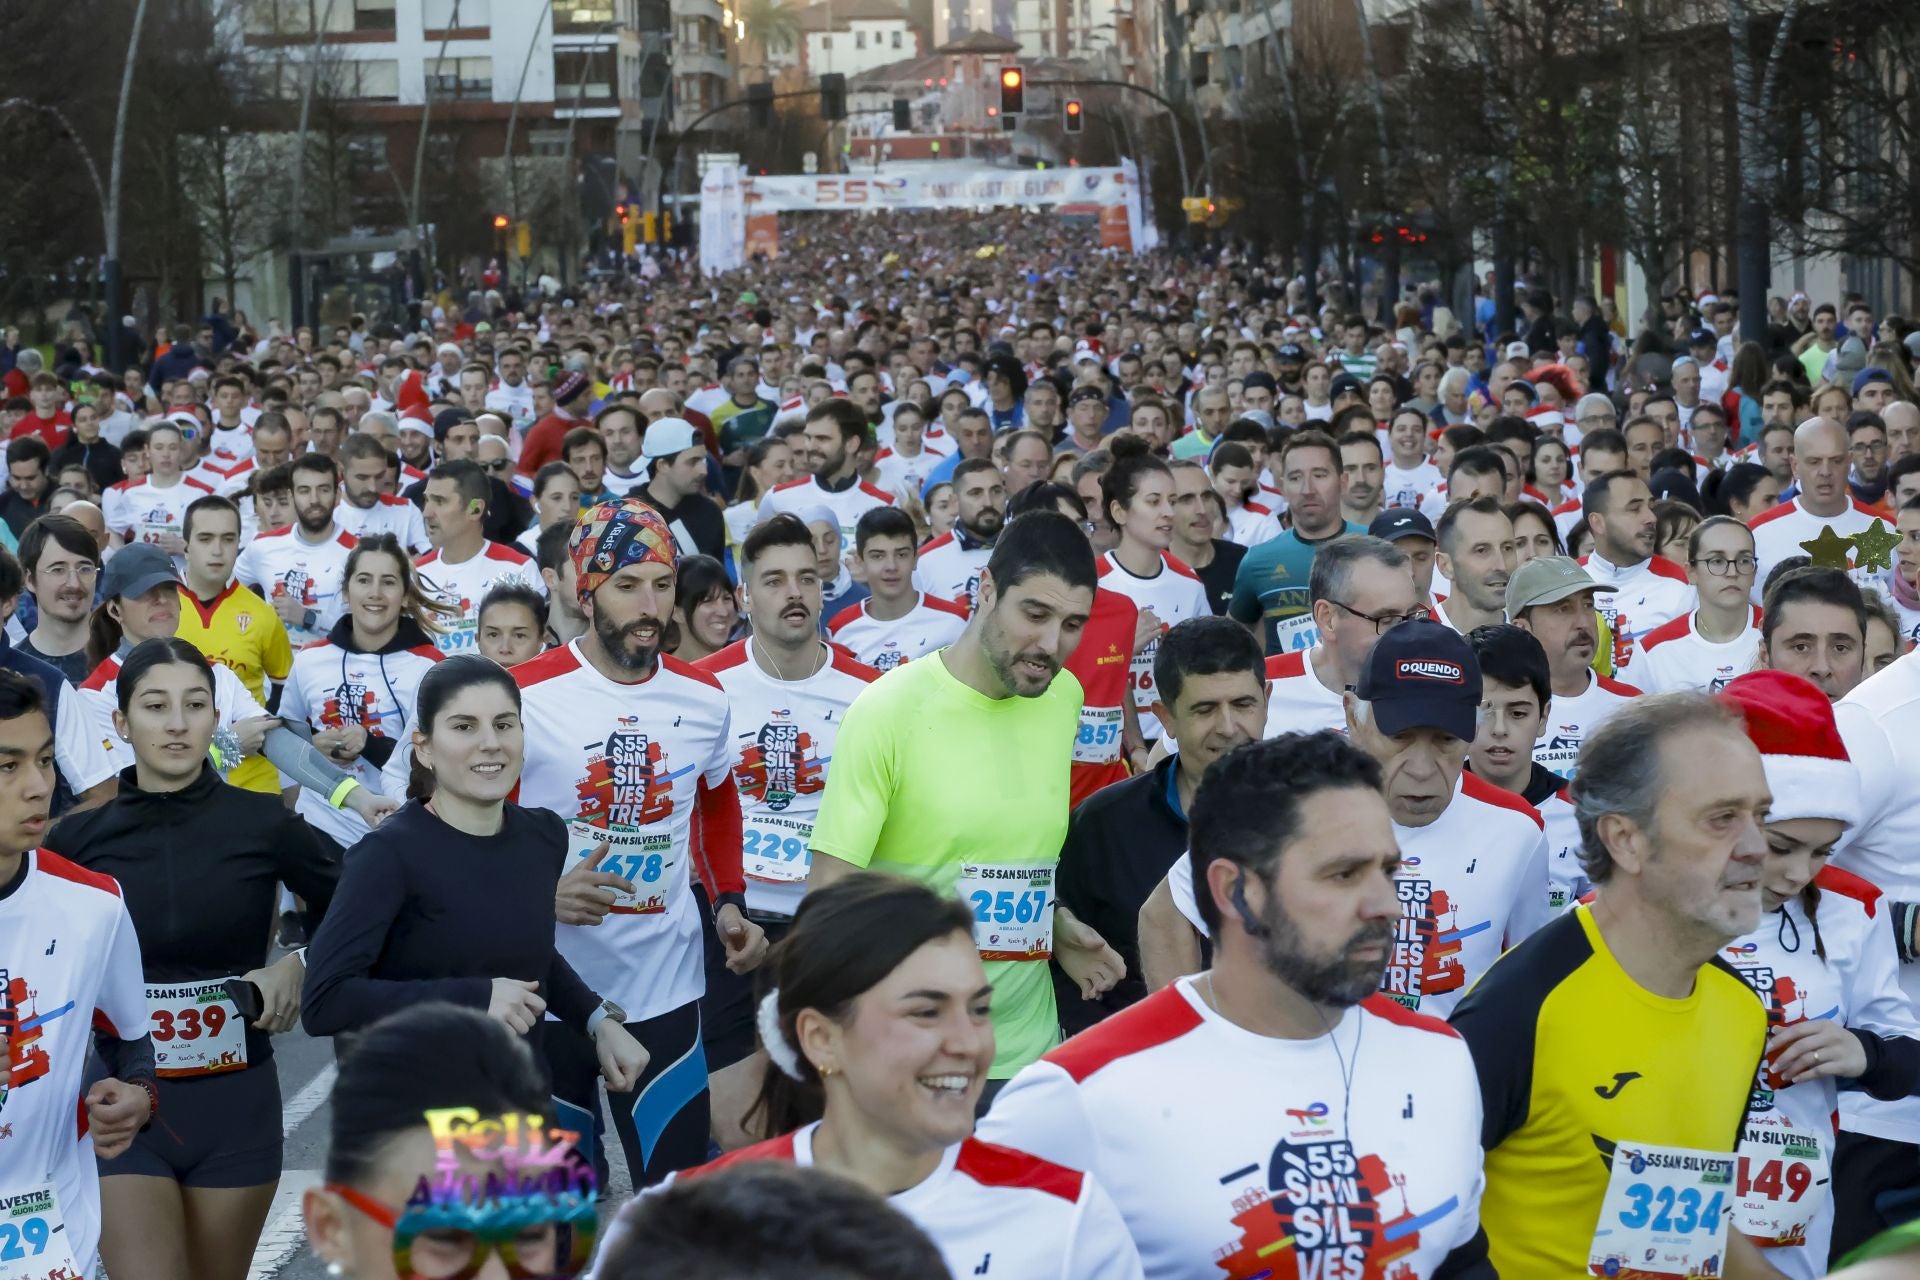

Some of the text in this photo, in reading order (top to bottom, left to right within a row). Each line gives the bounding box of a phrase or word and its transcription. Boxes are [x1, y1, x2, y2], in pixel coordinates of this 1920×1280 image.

[816, 181, 868, 203] 55
[603, 522, 626, 550] SPBV
[1401, 662, 1460, 677] OQUENDO
[349, 686, 366, 696] 55
[776, 727, 799, 742] 55
[1078, 723, 1118, 745] 857
[625, 736, 648, 752] 55
[764, 736, 796, 752] SAN
[613, 746, 646, 765] SAN
[764, 752, 795, 768] SIL
[1536, 753, 1548, 761] 55
[1548, 751, 1567, 761] SAN
[614, 766, 645, 785] SIL
[765, 768, 796, 782] VES
[613, 785, 646, 804] VES
[608, 804, 643, 826] TRE
[764, 817, 783, 826] SAN
[592, 831, 671, 845] 55 SAN SILVESTRE
[579, 849, 663, 883] 678
[982, 868, 1052, 880] 55 SAN SILVESTRE
[1398, 882, 1430, 900] 55
[970, 889, 1046, 924] 2567
[154, 988, 177, 999] SAN
[151, 1004, 226, 1042] 339
[1762, 1131, 1818, 1149] SILVESTRE
[1307, 1143, 1356, 1178] 55
[1647, 1153, 1663, 1167] 55
[1663, 1154, 1682, 1169] SAN
[1284, 1167, 1360, 1206] SAN
[35, 1202, 52, 1211] 2024
[1619, 1183, 1724, 1236] 3234
[1292, 1206, 1363, 1249] SIL
[1296, 1245, 1366, 1280] VES
